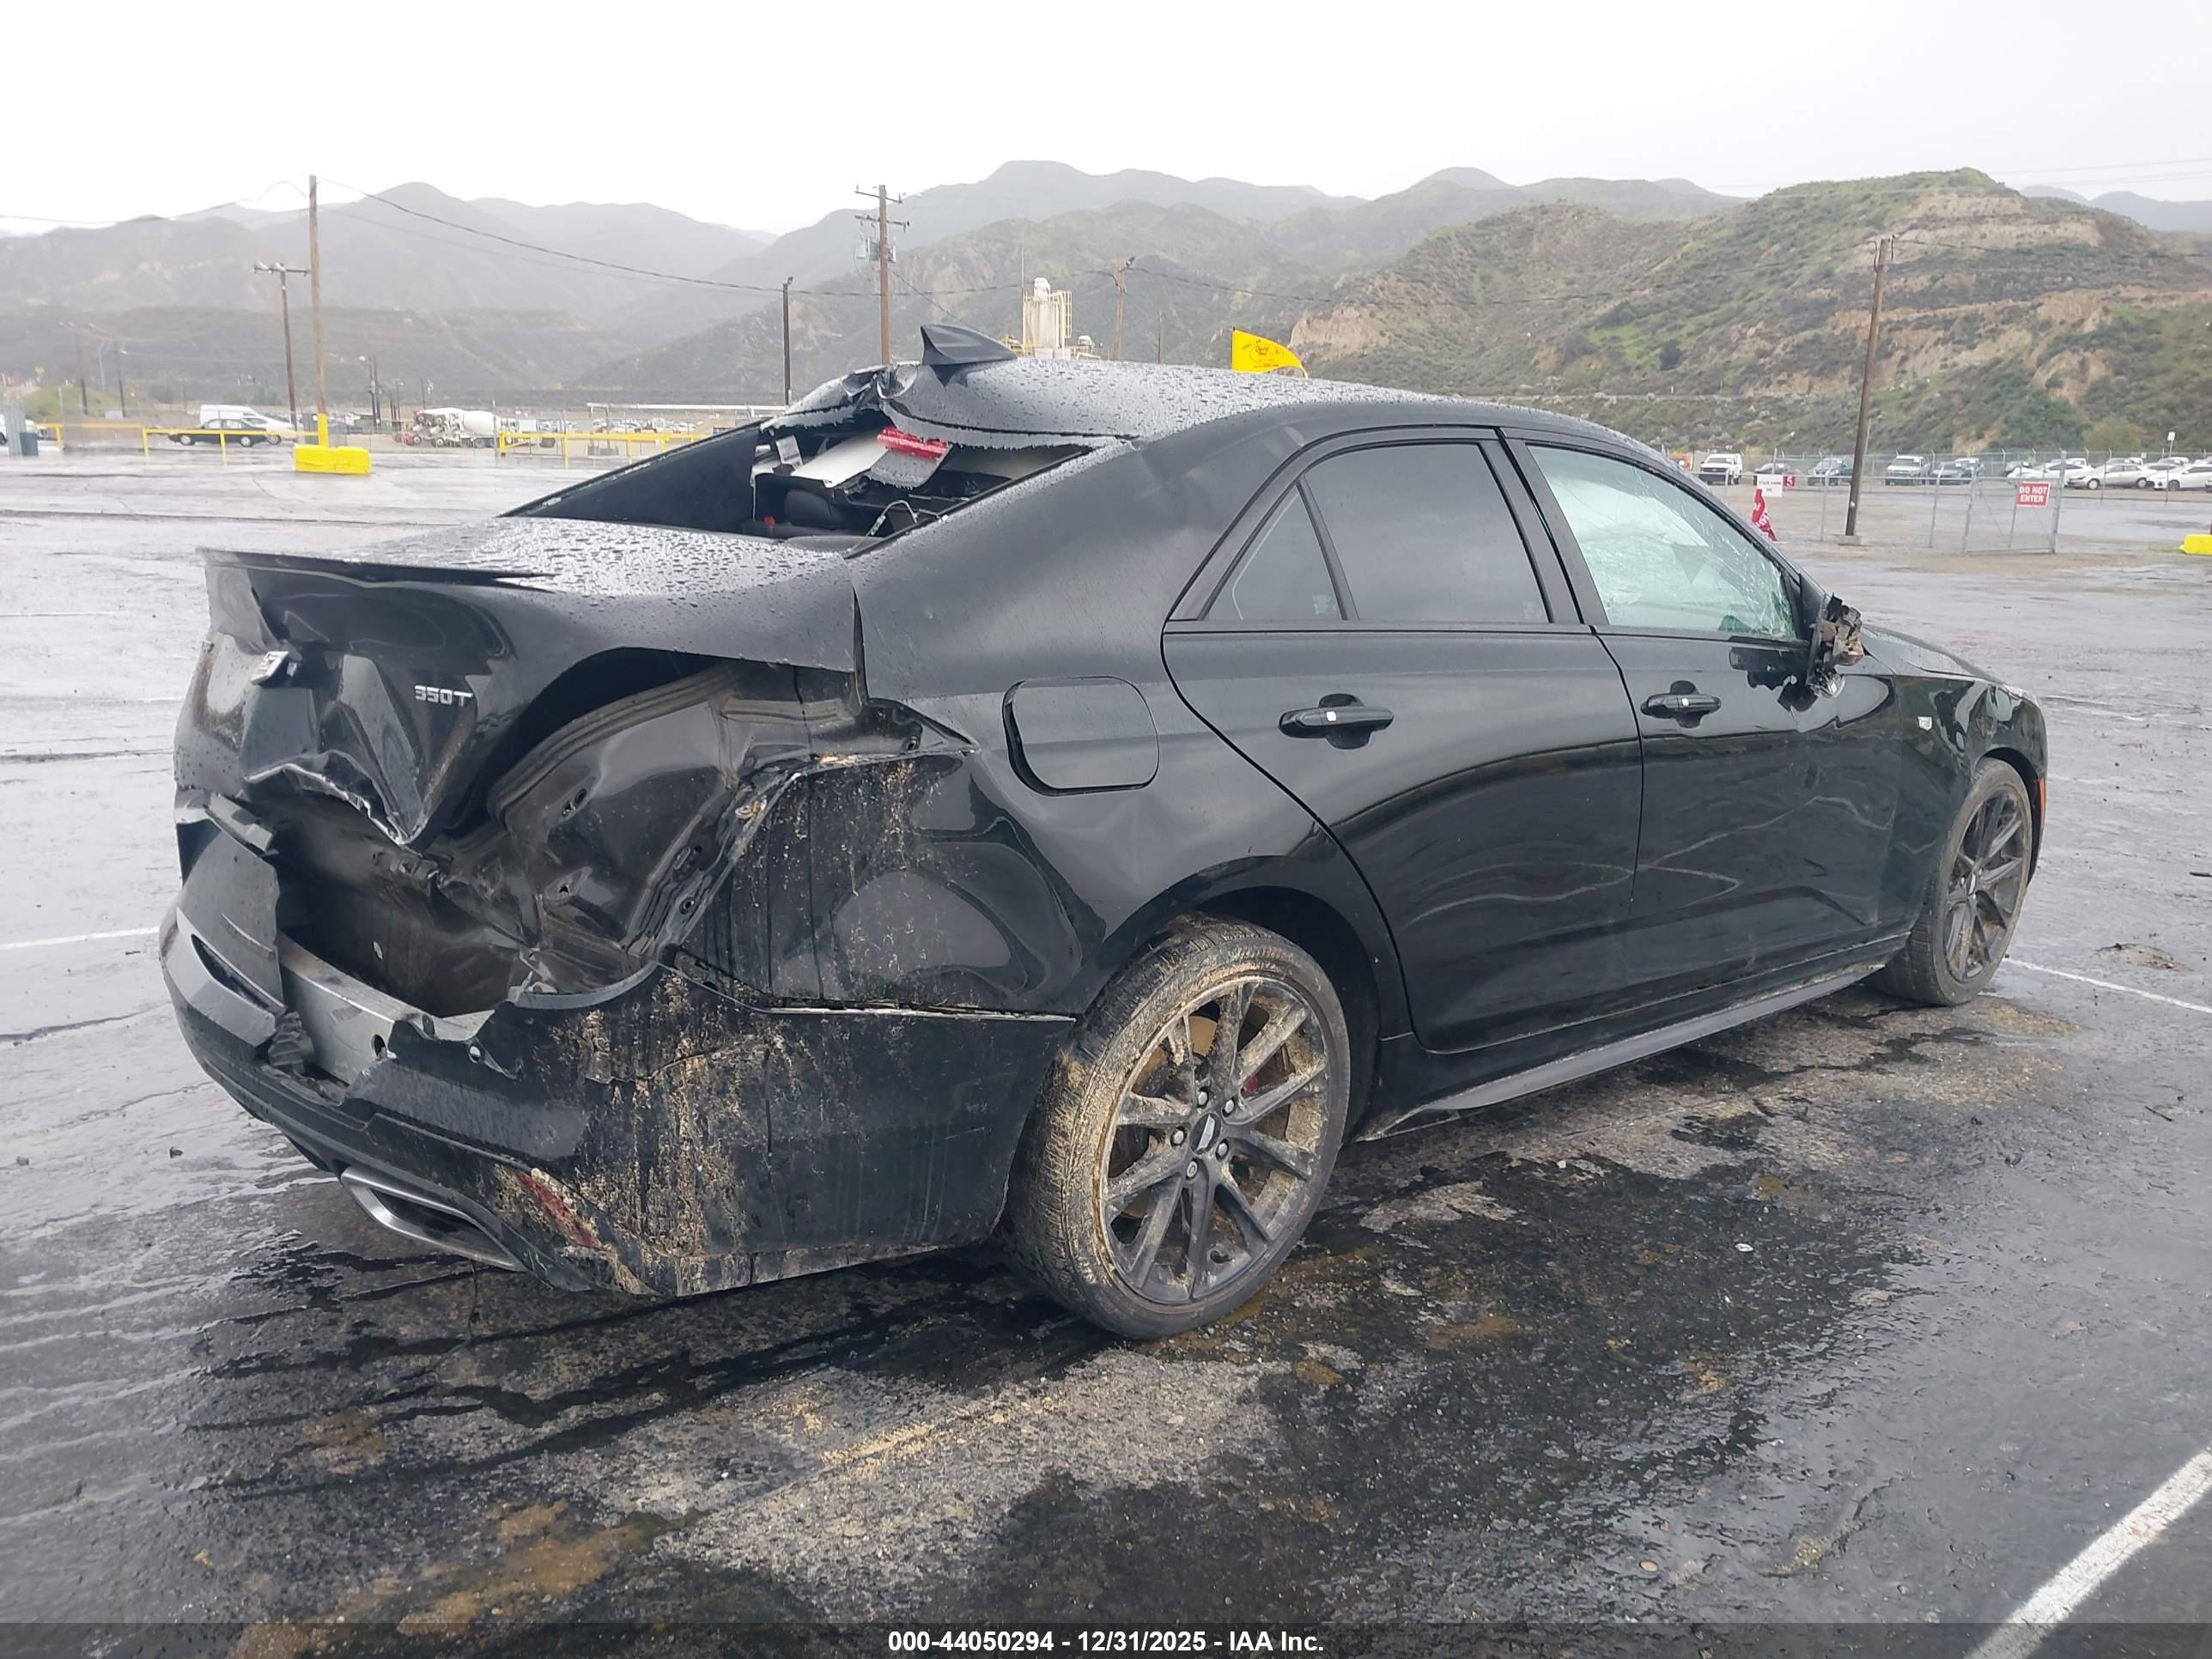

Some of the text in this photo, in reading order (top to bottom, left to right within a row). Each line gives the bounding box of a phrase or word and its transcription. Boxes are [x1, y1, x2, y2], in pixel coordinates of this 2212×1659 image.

[1786, 476, 1793, 487] 5
[2019, 486, 2048, 495] DO NOT
[2020, 494, 2044, 503] ENTER
[414, 684, 473, 708] 350T
